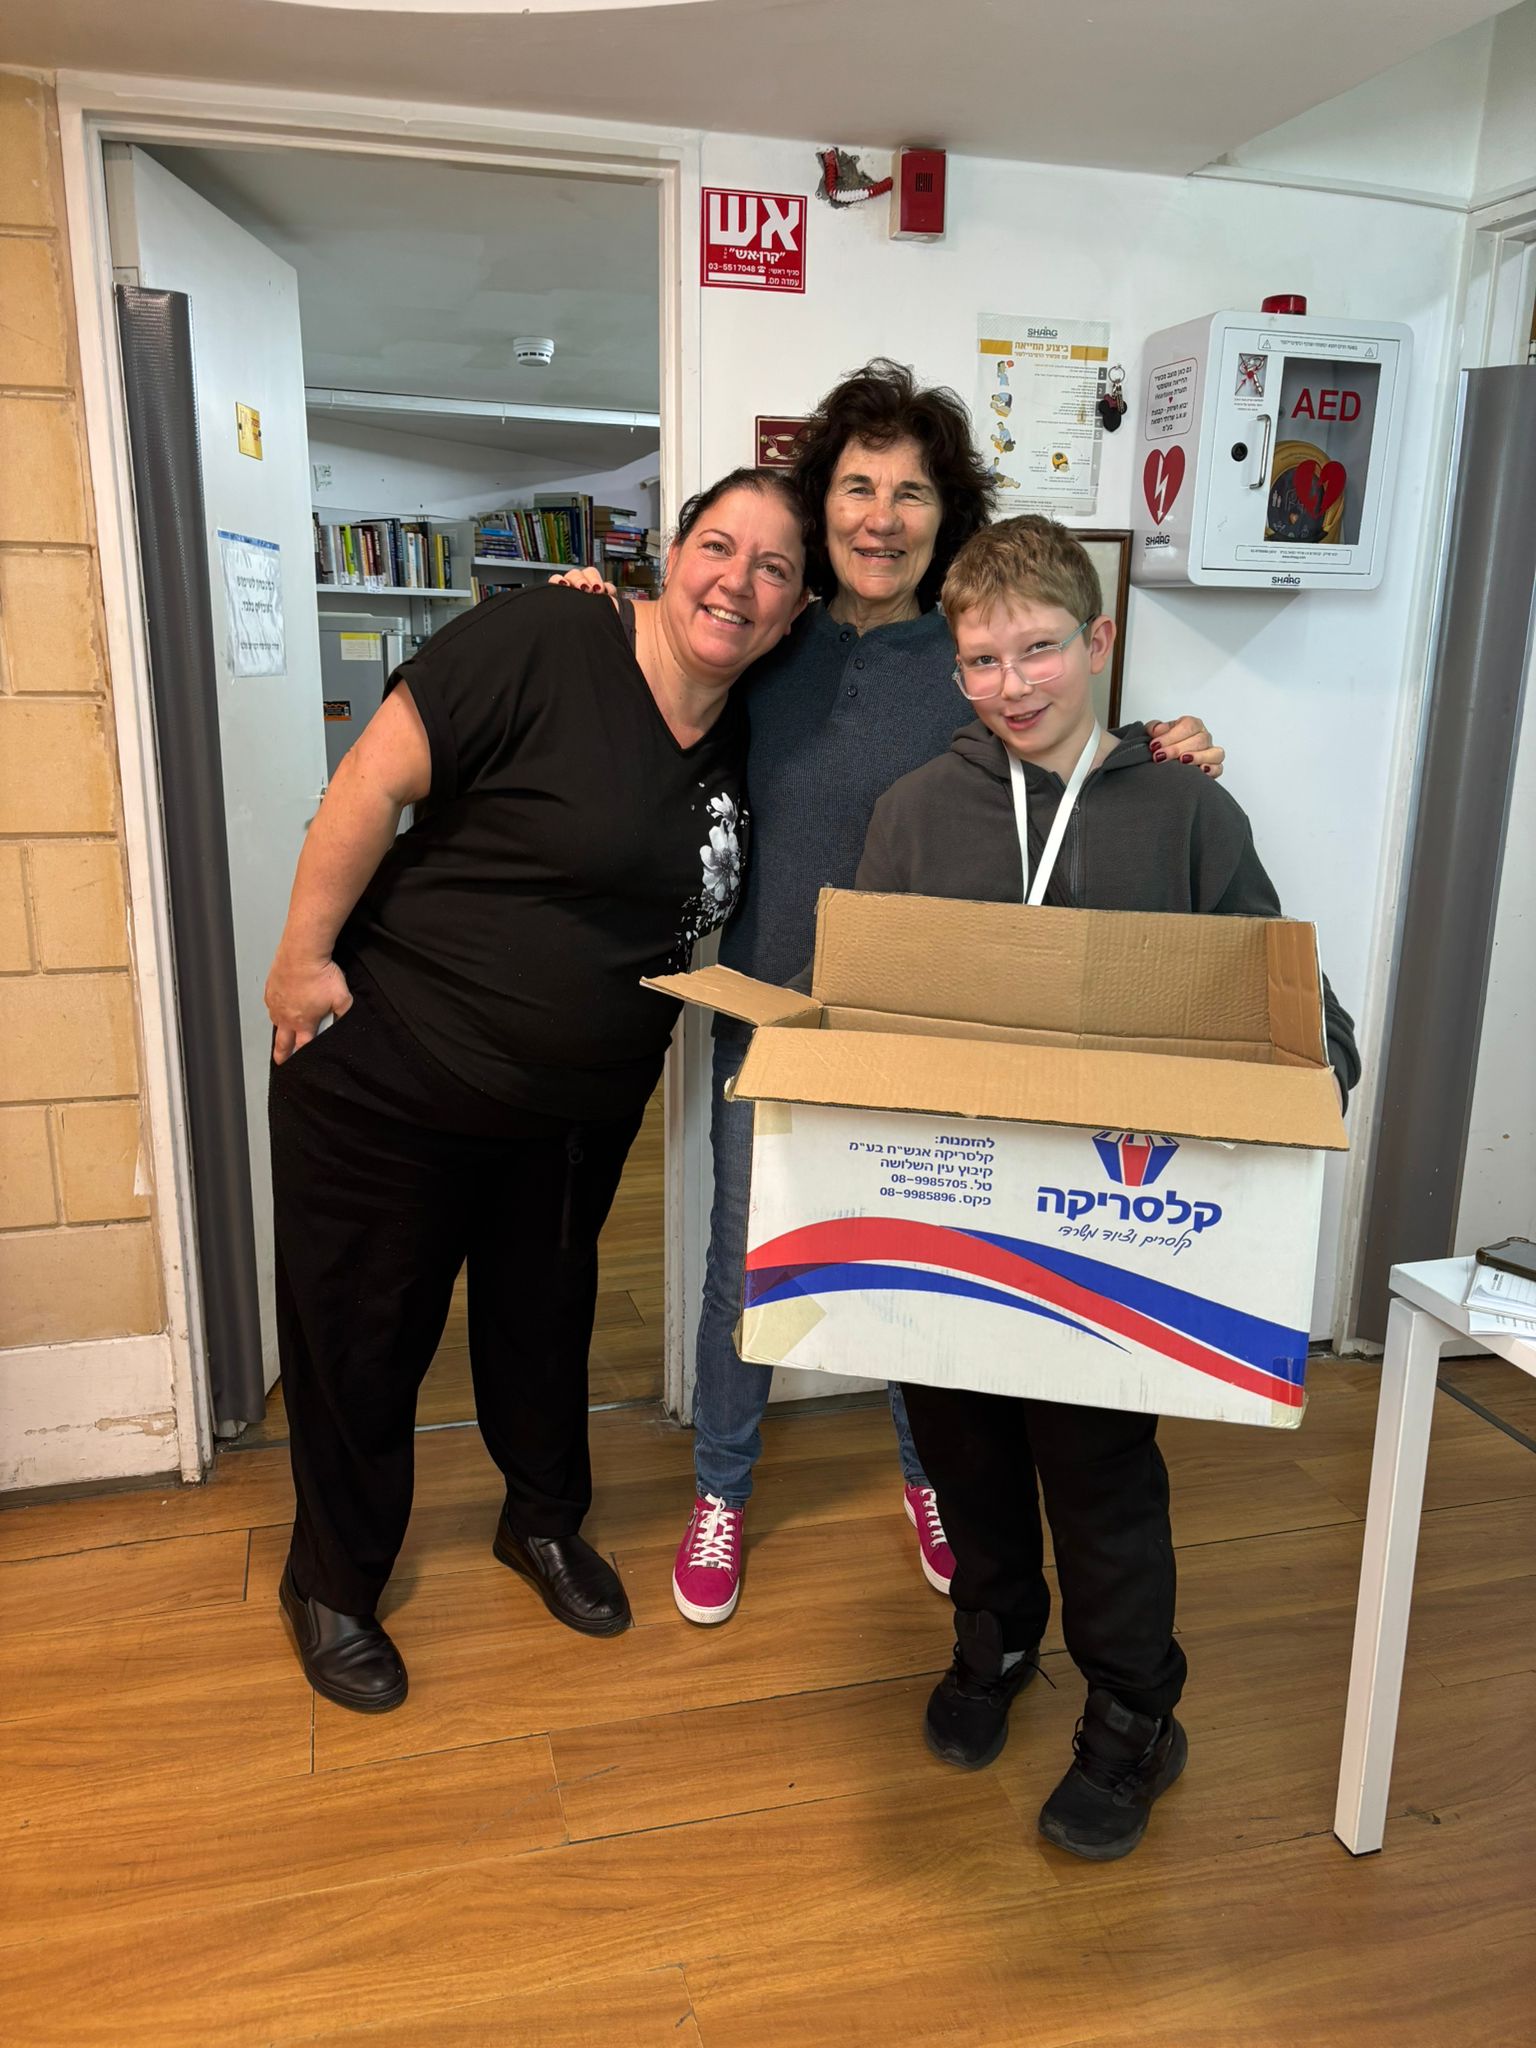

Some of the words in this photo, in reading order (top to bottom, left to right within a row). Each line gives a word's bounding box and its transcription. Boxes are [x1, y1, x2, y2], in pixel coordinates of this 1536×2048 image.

[709, 193, 800, 251] אש
[708, 262, 756, 273] 03-5517048
[780, 277, 800, 287] עמדה
[1046, 343, 1069, 353] ביצוע
[1290, 387, 1362, 422] AED
[848, 1141, 884, 1154] בע"מ
[934, 1135, 996, 1149] להזמנות:
[886, 1145, 932, 1158] אגש"ח
[934, 1148, 995, 1165] קלסריקה
[880, 1158, 934, 1172] השלושה
[936, 1163, 954, 1175] עין
[958, 1165, 994, 1180] קיבוץ
[890, 1173, 968, 1190] 08-9985705
[969, 1179, 993, 1192] טל.
[879, 1187, 957, 1203] 08-9985896
[958, 1194, 992, 1207] פקס.
[1036, 1185, 1223, 1234] קלסריקה
[1057, 1223, 1100, 1242] משרדי
[1102, 1228, 1138, 1244] וציוד
[1138, 1228, 1194, 1256] קלסרים
